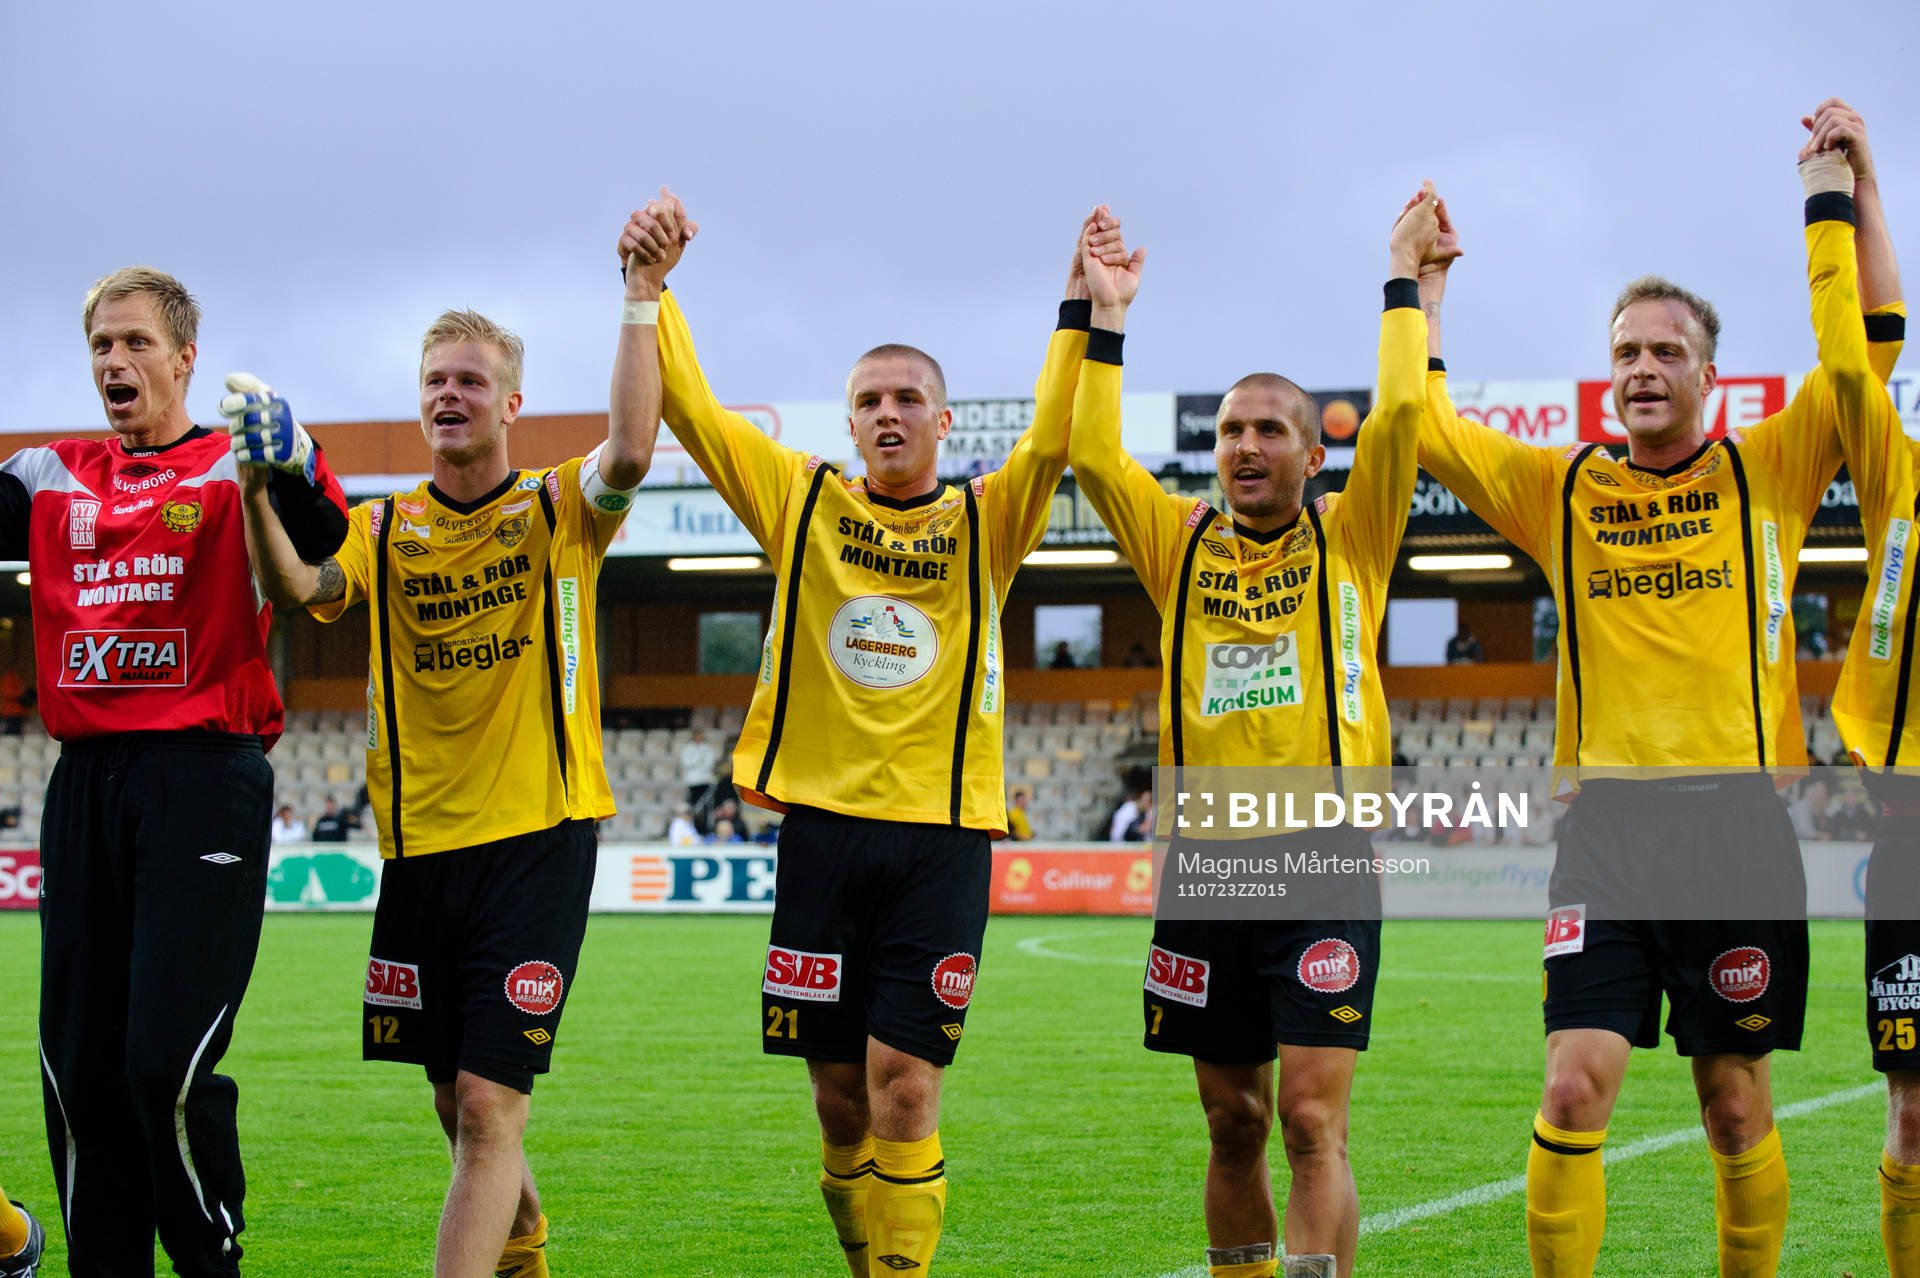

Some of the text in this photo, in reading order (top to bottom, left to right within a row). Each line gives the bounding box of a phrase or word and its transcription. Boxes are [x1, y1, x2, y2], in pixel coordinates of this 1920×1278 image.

[72, 502, 97, 517] SYD
[1589, 490, 1720, 524] STÅL & RÖR
[72, 518, 92, 531] UST
[72, 532, 93, 545] RAN
[838, 515, 957, 556] STÅL & RÖR
[1595, 517, 1714, 547] MONTAGE
[73, 553, 184, 582] STÅL & RÖR
[403, 554, 531, 597] STÅL & RÖR
[839, 543, 949, 581] MONTAGE
[77, 582, 174, 607] MONTAGE
[1197, 569, 1239, 593] STÅ
[1245, 586, 1263, 600] &
[1615, 559, 1733, 599] beglast
[1873, 520, 1908, 657] blekingeflyg.se
[417, 581, 528, 622] MONTAGE
[69, 635, 178, 681] EXTRA
[561, 580, 577, 712] blekingeflyg.se
[845, 636, 917, 659] LAGERBERG
[1343, 584, 1361, 720] blekingeflyg.se
[853, 653, 907, 675] Kyckling
[366, 959, 418, 999] SVB
[767, 949, 839, 990] SVB
[1150, 948, 1206, 994] SVB
[1308, 953, 1351, 977] mix
[1720, 960, 1763, 984] mix
[516, 979, 557, 998] mix
[941, 971, 973, 991] mix
[1870, 975, 1920, 997] JÄRLE
[369, 1014, 400, 1043] 12
[766, 1005, 798, 1039] 21
[1151, 1004, 1164, 1035] 7
[1878, 1017, 1917, 1051] 25
